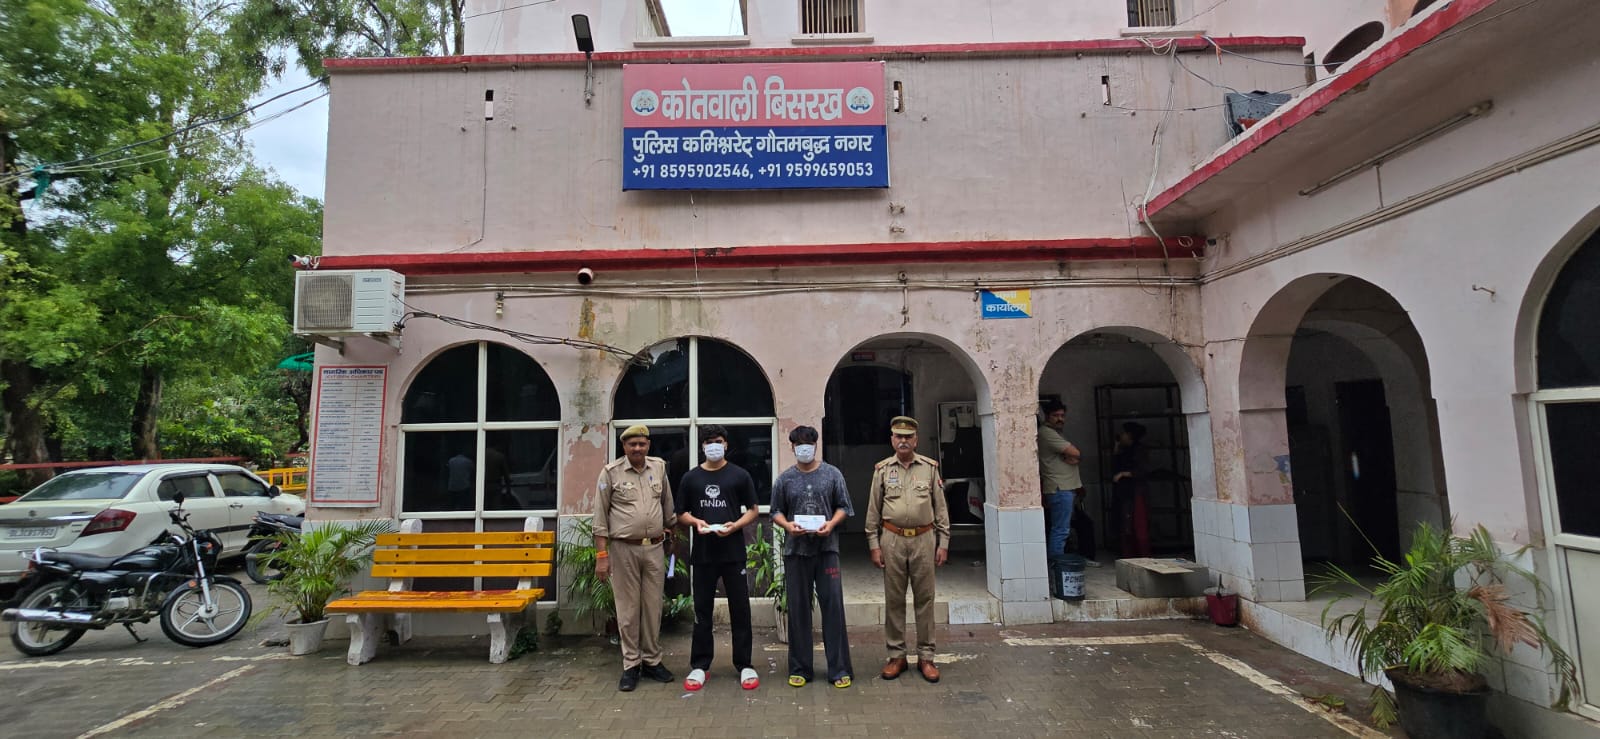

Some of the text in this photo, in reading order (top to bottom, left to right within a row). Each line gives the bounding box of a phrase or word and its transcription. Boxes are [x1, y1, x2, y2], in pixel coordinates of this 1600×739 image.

[661, 75, 844, 121] कोतवाली बिसरख
[632, 130, 679, 163] पुलिस
[756, 129, 831, 161] गौतमबुद्ध
[834, 135, 874, 152] नगर
[632, 162, 873, 179] +91 8595902546, +91 9599659053
